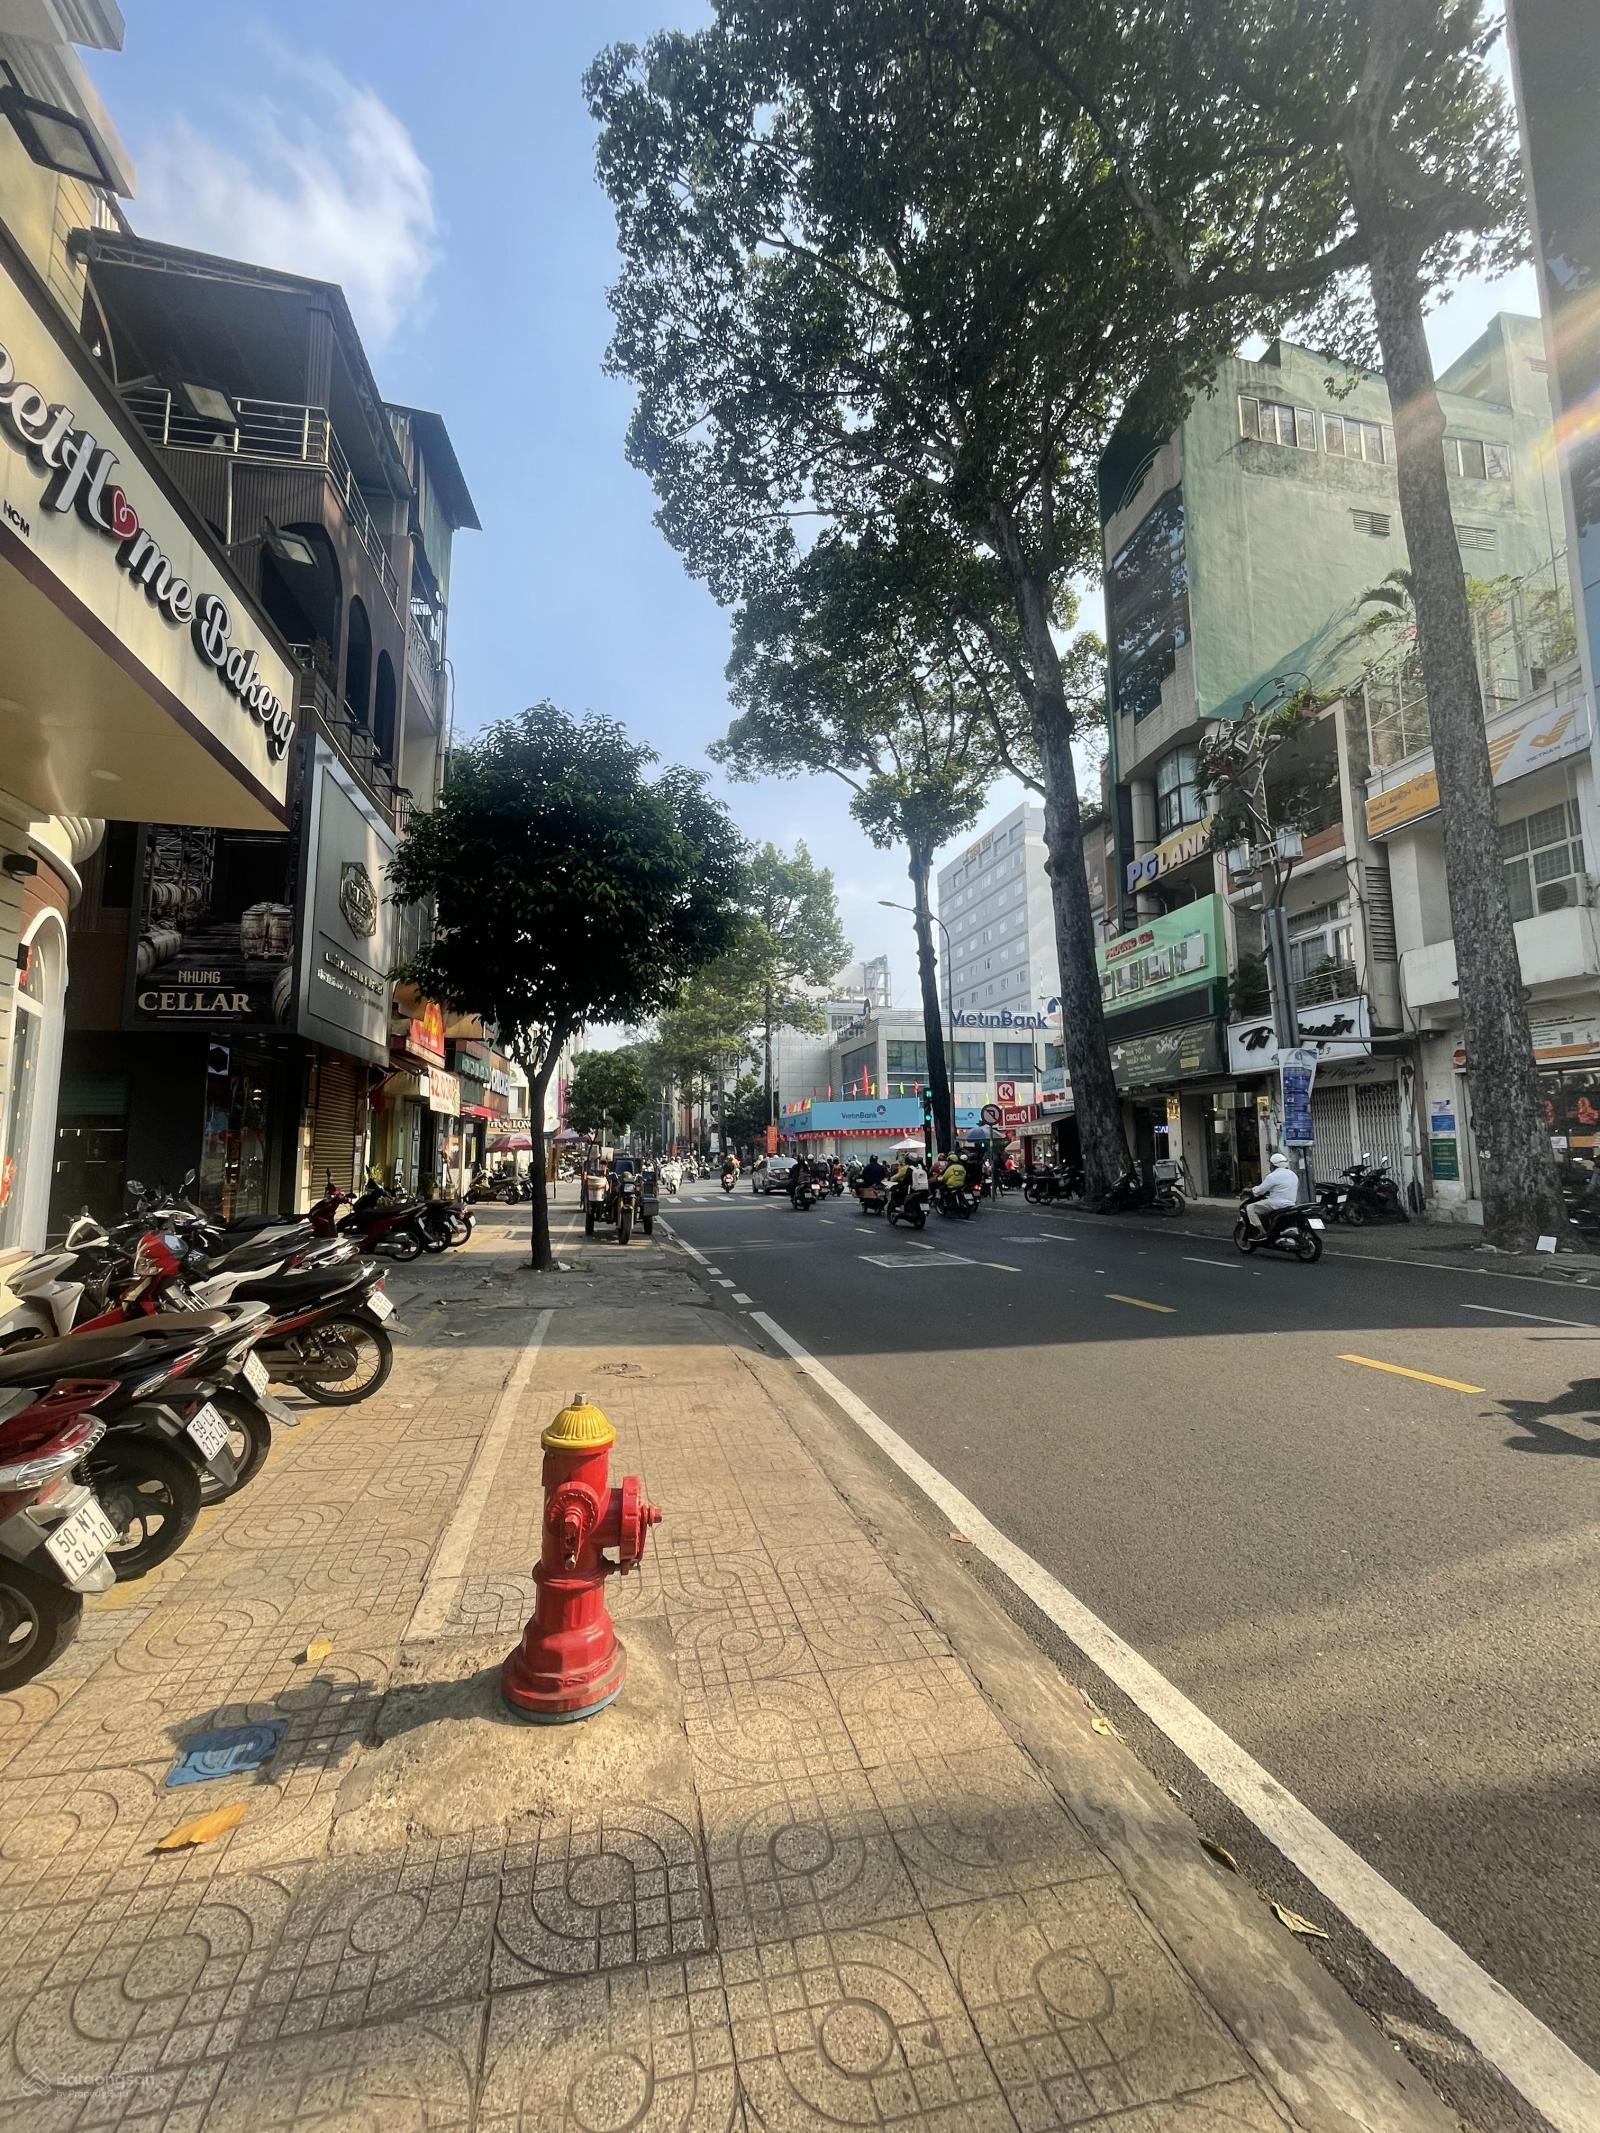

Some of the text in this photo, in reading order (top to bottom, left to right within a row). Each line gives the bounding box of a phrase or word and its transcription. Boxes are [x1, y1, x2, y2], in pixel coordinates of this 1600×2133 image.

[201, 595, 295, 761] Bakery
[178, 970, 221, 984] NHUNG
[138, 991, 252, 1012] CELLAR
[951, 1009, 1048, 1030] VietinBank
